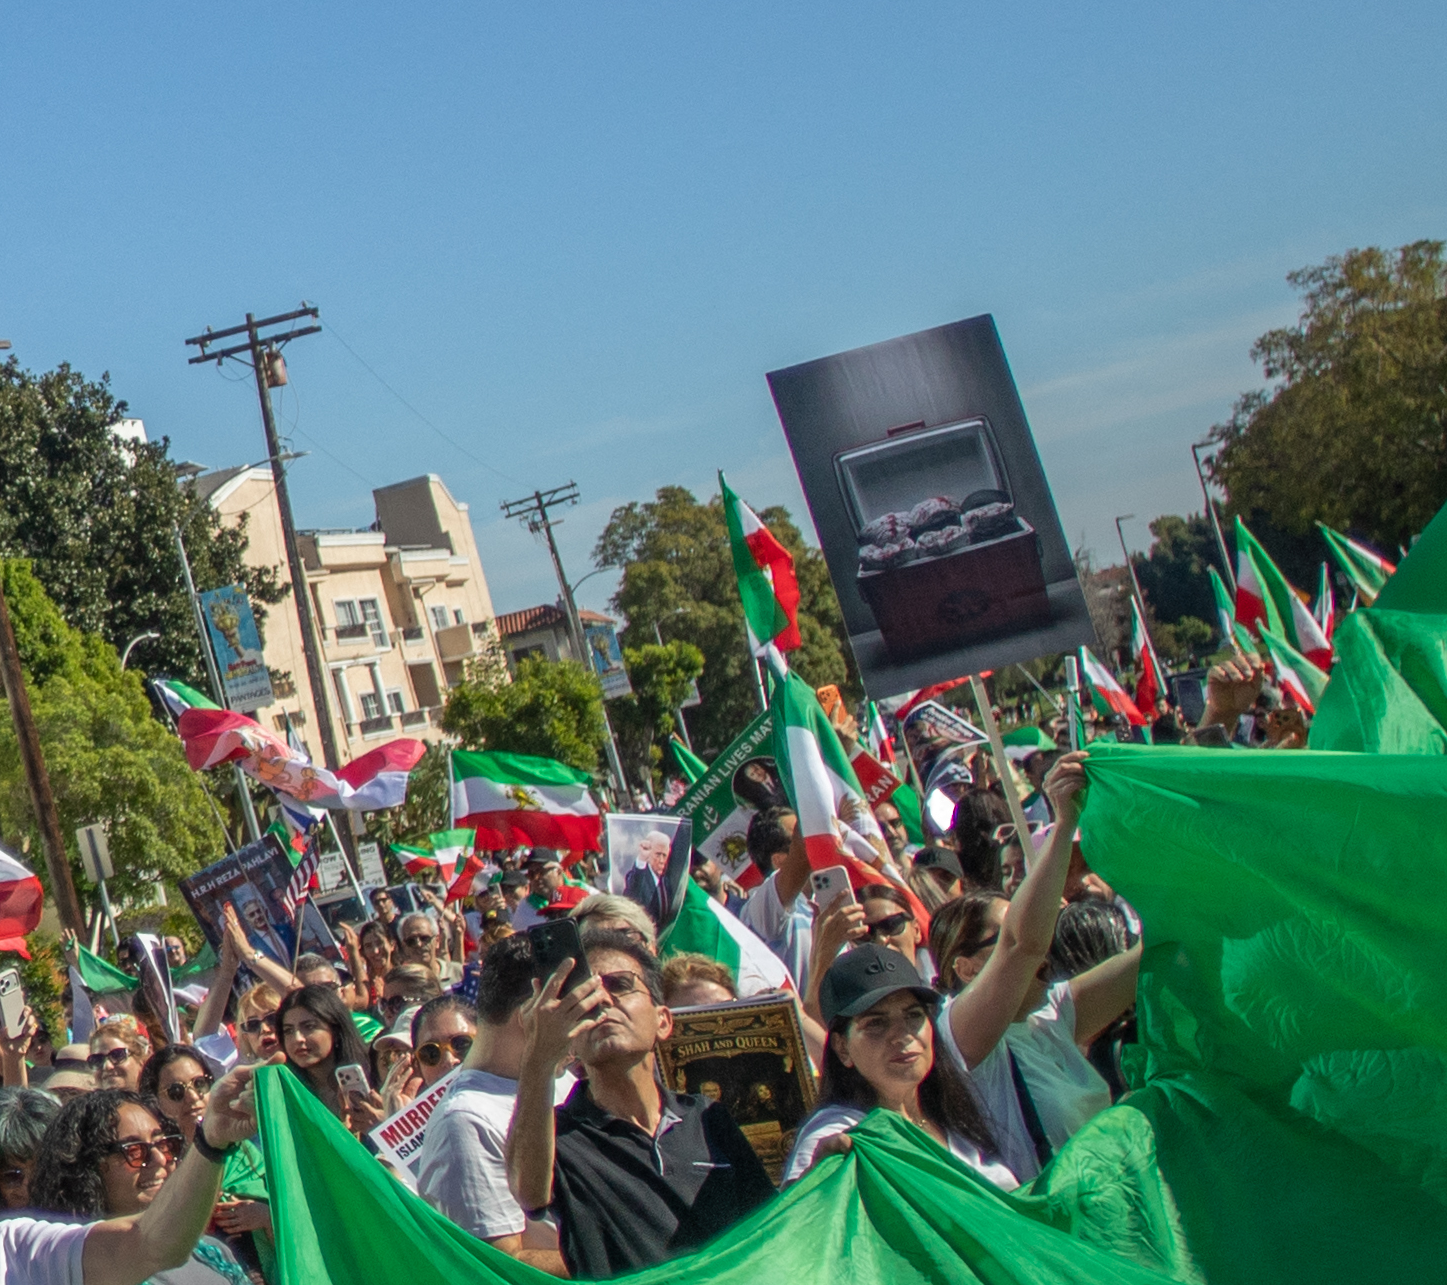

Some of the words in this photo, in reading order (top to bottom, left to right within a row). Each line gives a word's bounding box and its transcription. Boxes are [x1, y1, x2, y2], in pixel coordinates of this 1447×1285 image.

[676, 774, 722, 817] RANIAN
[717, 742, 753, 778] LIVES
[749, 717, 774, 746] MAT
[865, 774, 894, 804] RAN
[215, 867, 242, 886] REZA
[677, 1041, 711, 1058] SHAH
[713, 1039, 734, 1050] AND
[735, 1036, 779, 1050] QUEEN
[379, 1078, 454, 1150] MURDE
[395, 1129, 426, 1160] ISLAM
